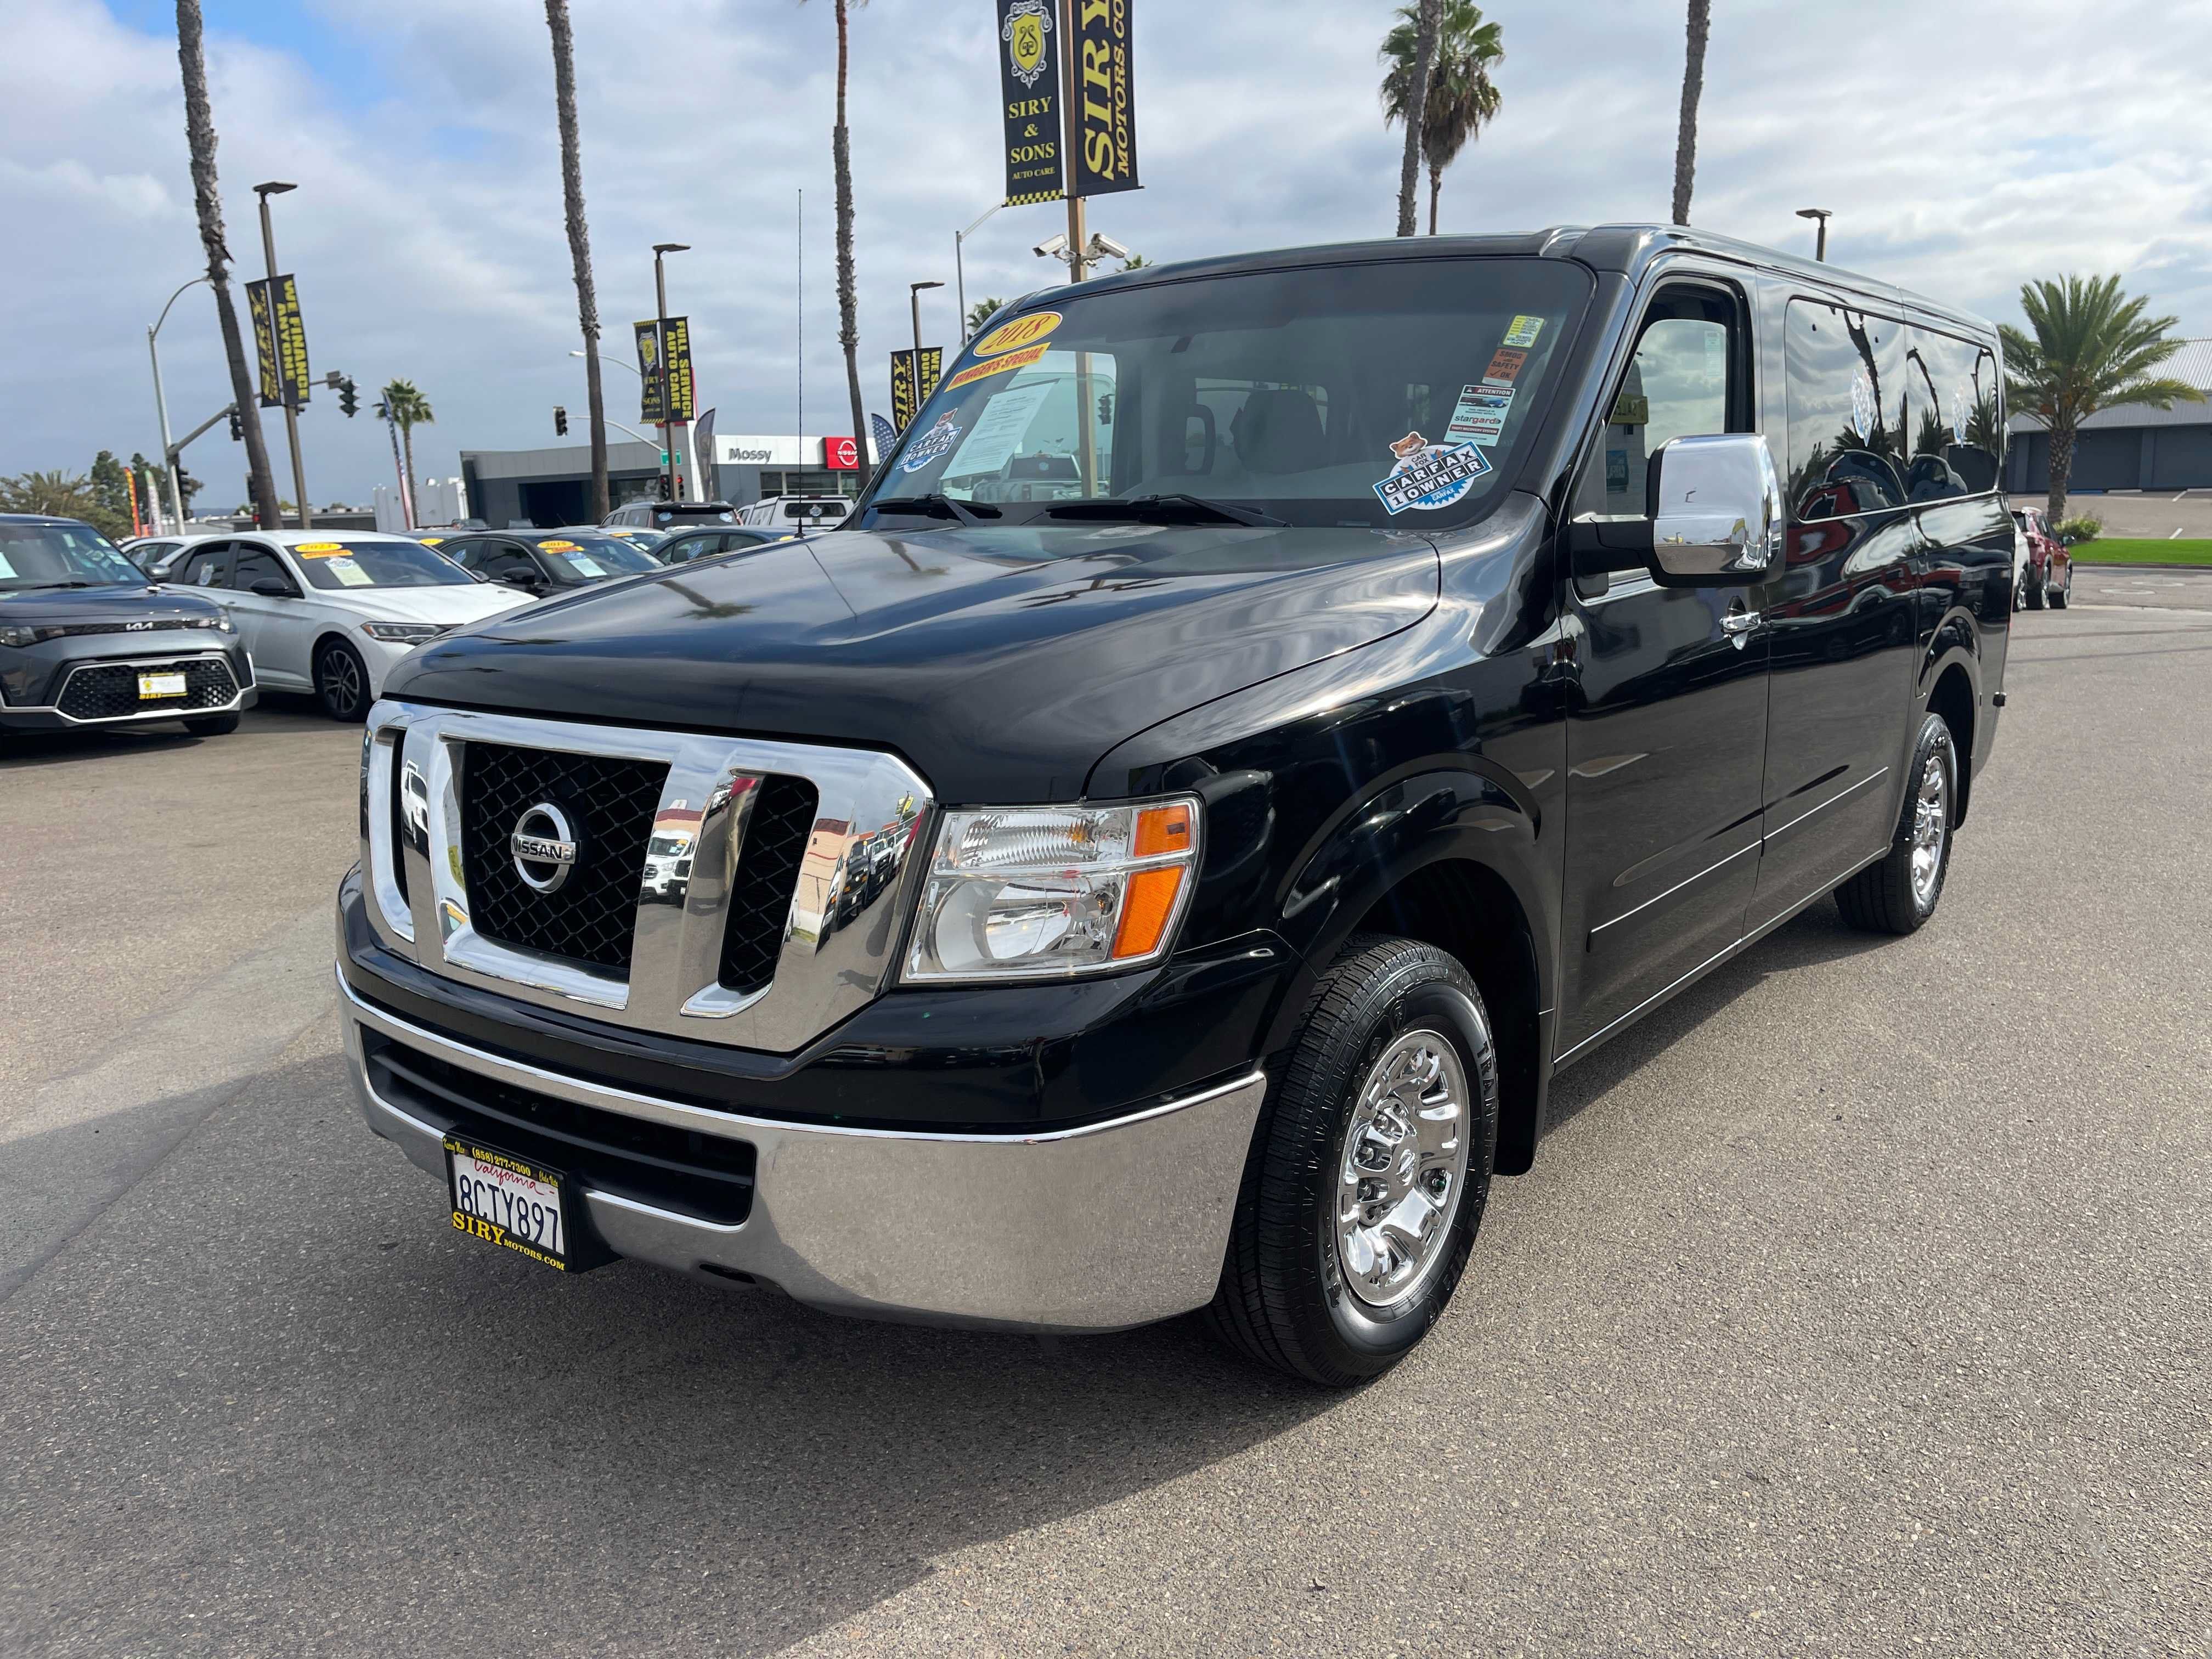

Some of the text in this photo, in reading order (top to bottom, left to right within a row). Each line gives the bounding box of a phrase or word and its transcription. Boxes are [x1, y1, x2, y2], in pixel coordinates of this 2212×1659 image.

[1008, 96, 1052, 119] SIRY
[1024, 123, 1039, 137] &
[1011, 142, 1055, 164] SONS
[1012, 166, 1055, 180] AUTO CARE
[276, 303, 296, 381] ANYONE
[283, 280, 309, 399] WE FINANCE
[982, 316, 1051, 351] 2018
[667, 331, 681, 409] AUTO CARE
[675, 320, 692, 419] FULL SERVICE
[921, 352, 930, 380] OUR
[930, 351, 940, 371] WE
[1001, 347, 1044, 369] SPECIAL
[1491, 361, 1519, 370] SAFETY
[894, 356, 910, 430] SIRY
[1454, 415, 1497, 424] stargard
[910, 434, 954, 452] CARFAX
[910, 443, 947, 460] OWNER
[729, 448, 771, 463] Mossy
[1412, 453, 1426, 462] CAR
[1415, 458, 1430, 467] FOX
[1384, 450, 1473, 493] CARFAX
[1392, 496, 1403, 506] 1
[1407, 461, 1481, 498] OWNER
[1432, 488, 1455, 500] CARFAX
[512, 834, 562, 859] NISSAN
[472, 1147, 531, 1177] (858) 277-7300
[474, 1159, 544, 1195] California
[459, 1174, 558, 1252] 8CTY897
[452, 1211, 565, 1271] SIRY MOTORS.COM
